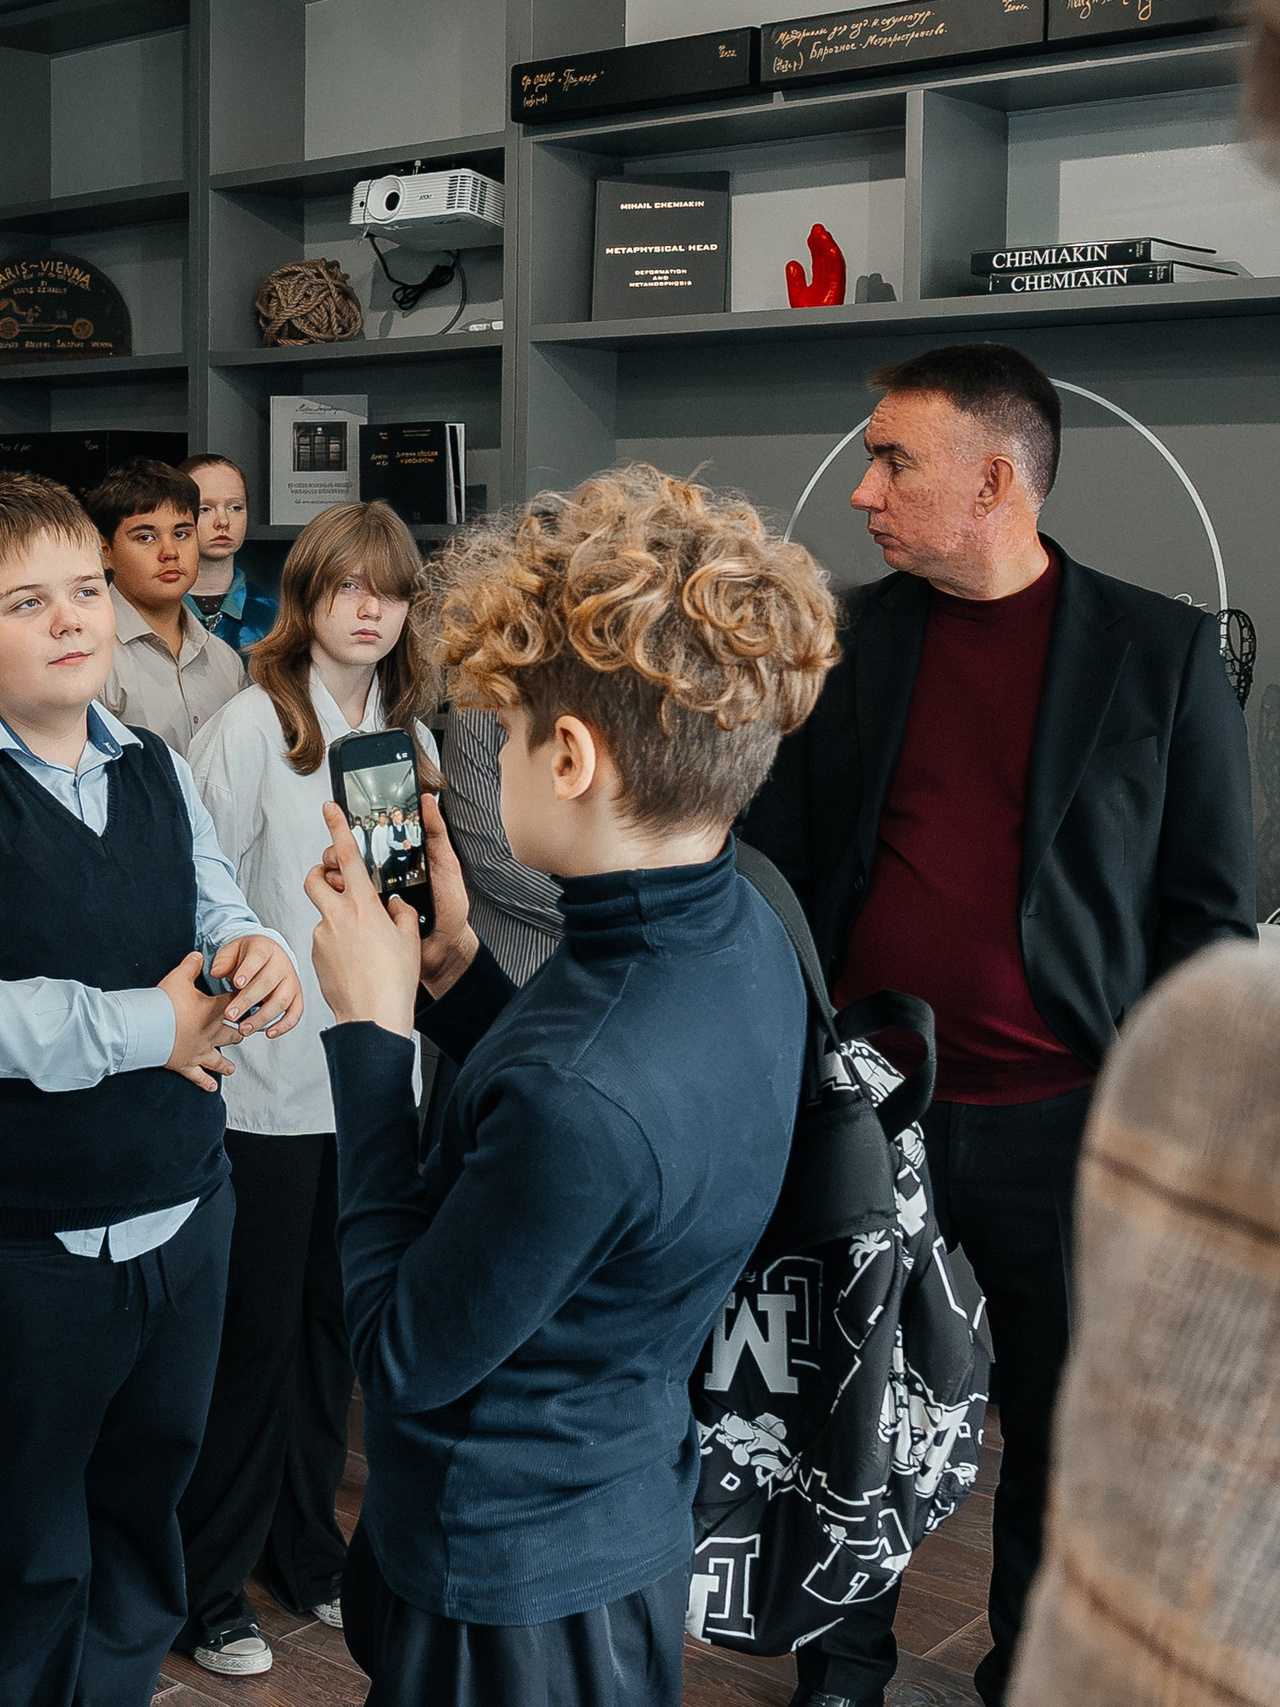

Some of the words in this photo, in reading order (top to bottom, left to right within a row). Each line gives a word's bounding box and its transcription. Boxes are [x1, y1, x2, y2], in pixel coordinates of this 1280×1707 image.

[620, 202, 652, 210] MIHAIL
[654, 201, 705, 209] CHEMIAKIN
[605, 244, 685, 255] METAPHYSICAL
[688, 243, 718, 252] HEAD
[992, 244, 1109, 269] CHEMIAKIN
[634, 268, 687, 276] DEFORMATION
[629, 280, 692, 288] METAMORPHOSIS
[1010, 269, 1129, 293] CHEMIAKIN
